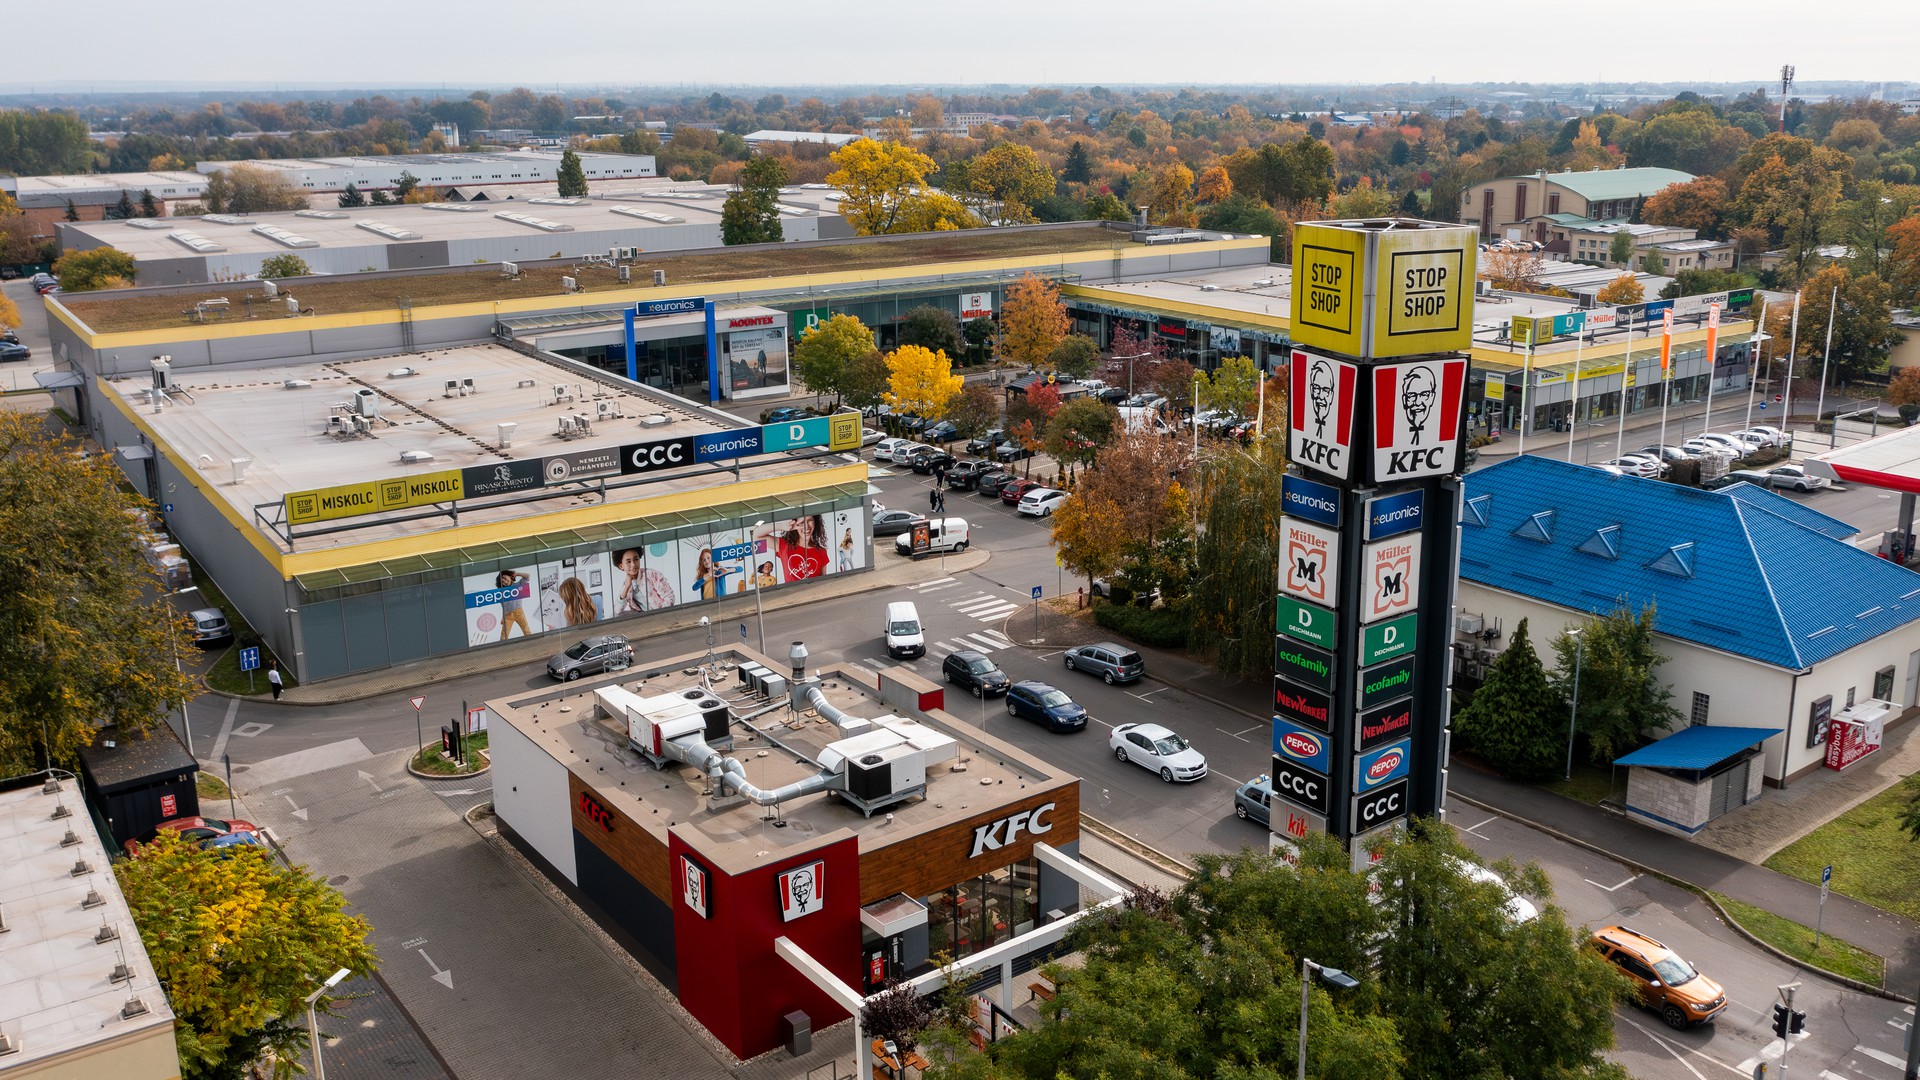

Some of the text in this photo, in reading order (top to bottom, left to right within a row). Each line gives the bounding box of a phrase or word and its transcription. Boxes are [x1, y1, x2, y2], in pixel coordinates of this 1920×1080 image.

[1312, 263, 1342, 285] STOP
[1406, 267, 1446, 288] STOP
[655, 300, 694, 312] euronics
[1311, 291, 1340, 314] SHOP
[1404, 296, 1446, 318] SHOP
[1702, 294, 1727, 305] KÄRCHER
[729, 315, 774, 328] MOUNTEX
[962, 309, 992, 318] Müller
[1566, 316, 1574, 328] D
[1594, 314, 1615, 323] Müller
[790, 424, 804, 440] D
[838, 424, 852, 432] STOP
[839, 432, 852, 440] SHOP
[707, 436, 758, 454] euronics
[579, 455, 610, 464] NEMZETI
[632, 443, 683, 468] CCC
[1300, 438, 1340, 471] KFC
[1386, 446, 1444, 476] KFC
[553, 466, 564, 475] 18
[387, 486, 401, 495] STOP
[411, 478, 460, 497] MISKOLC
[474, 476, 532, 492] RINASCIMENTO
[297, 498, 312, 508] STOP
[322, 491, 374, 510] MISKOLC
[387, 494, 402, 502] SHOP
[1292, 492, 1336, 512] euronics
[298, 506, 313, 516] SHOP
[1380, 505, 1420, 524] euronics
[1289, 528, 1328, 549] Müller
[1376, 545, 1412, 562] Müller
[1297, 558, 1316, 582] M
[1383, 572, 1402, 598] M
[476, 588, 519, 606] pepco
[1299, 608, 1312, 626] D
[1288, 624, 1322, 640] DEICHMANN
[1384, 626, 1396, 644] D
[1374, 642, 1404, 657] DEICHMANN
[1280, 650, 1328, 678] ecofamily
[1366, 670, 1410, 694] ecofamily
[1286, 735, 1316, 754] PEPCO
[1832, 730, 1842, 766] easybox
[1370, 757, 1398, 775] PEPCO
[1280, 771, 1318, 800] CCC
[580, 792, 611, 832] KFC
[1363, 793, 1399, 820] CCC
[969, 803, 1055, 858] KFC
[1288, 813, 1308, 838] kik
[1824, 868, 1830, 880] P
